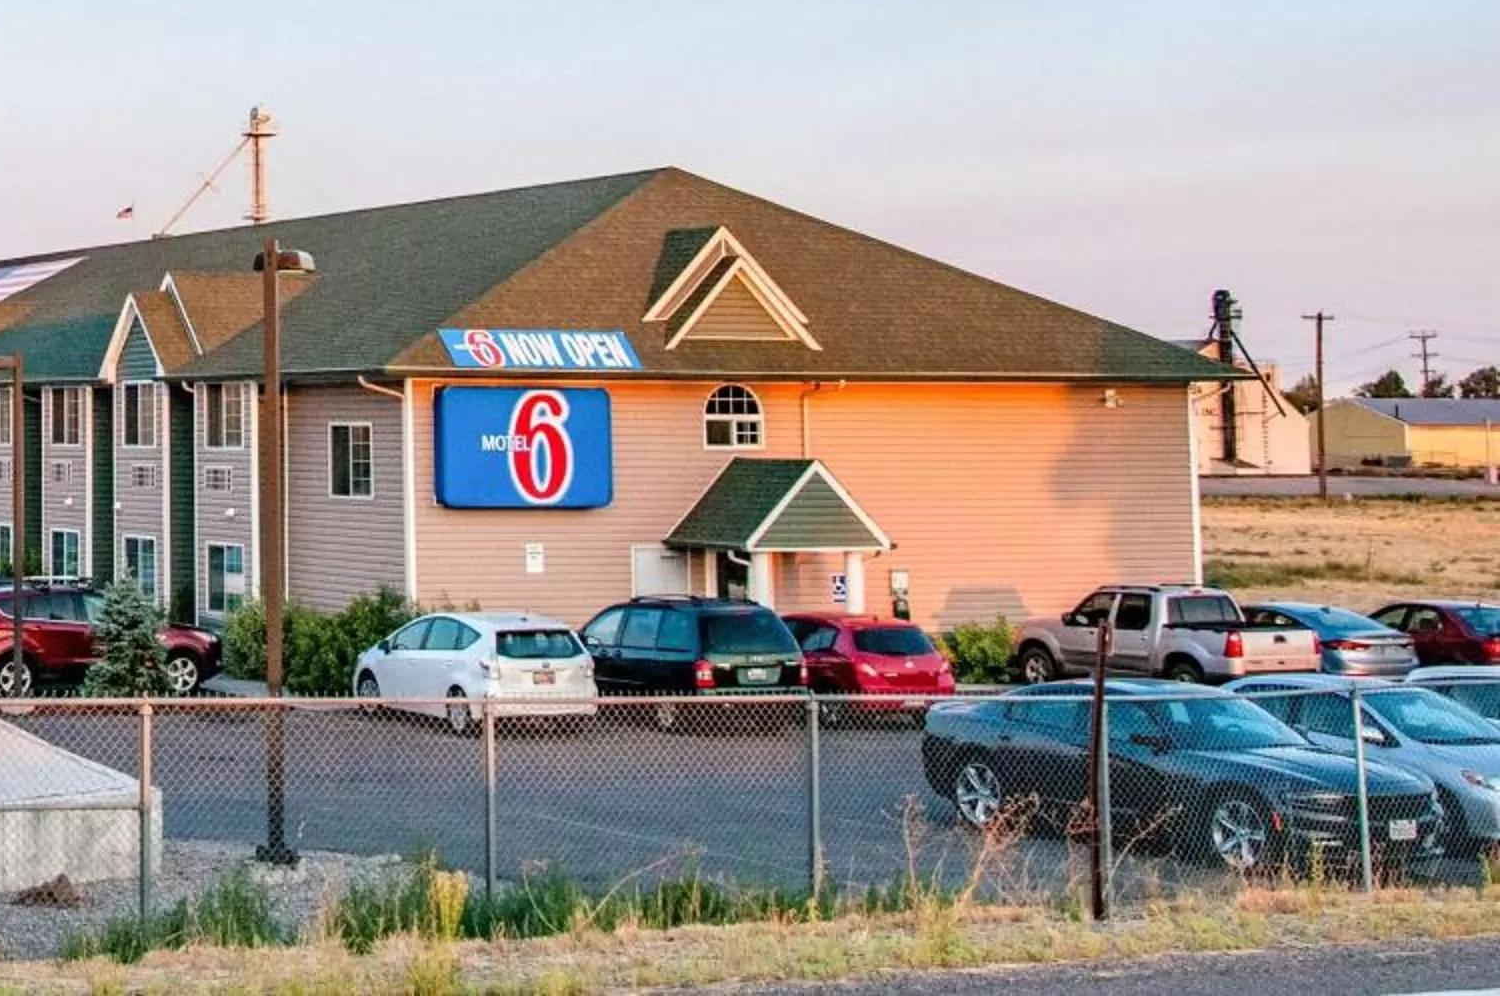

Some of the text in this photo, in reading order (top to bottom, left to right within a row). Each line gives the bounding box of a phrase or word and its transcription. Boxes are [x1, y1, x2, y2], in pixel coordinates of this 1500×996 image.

[465, 330, 632, 367] 6 NOW OPEN
[482, 391, 573, 504] MOTEL 6
